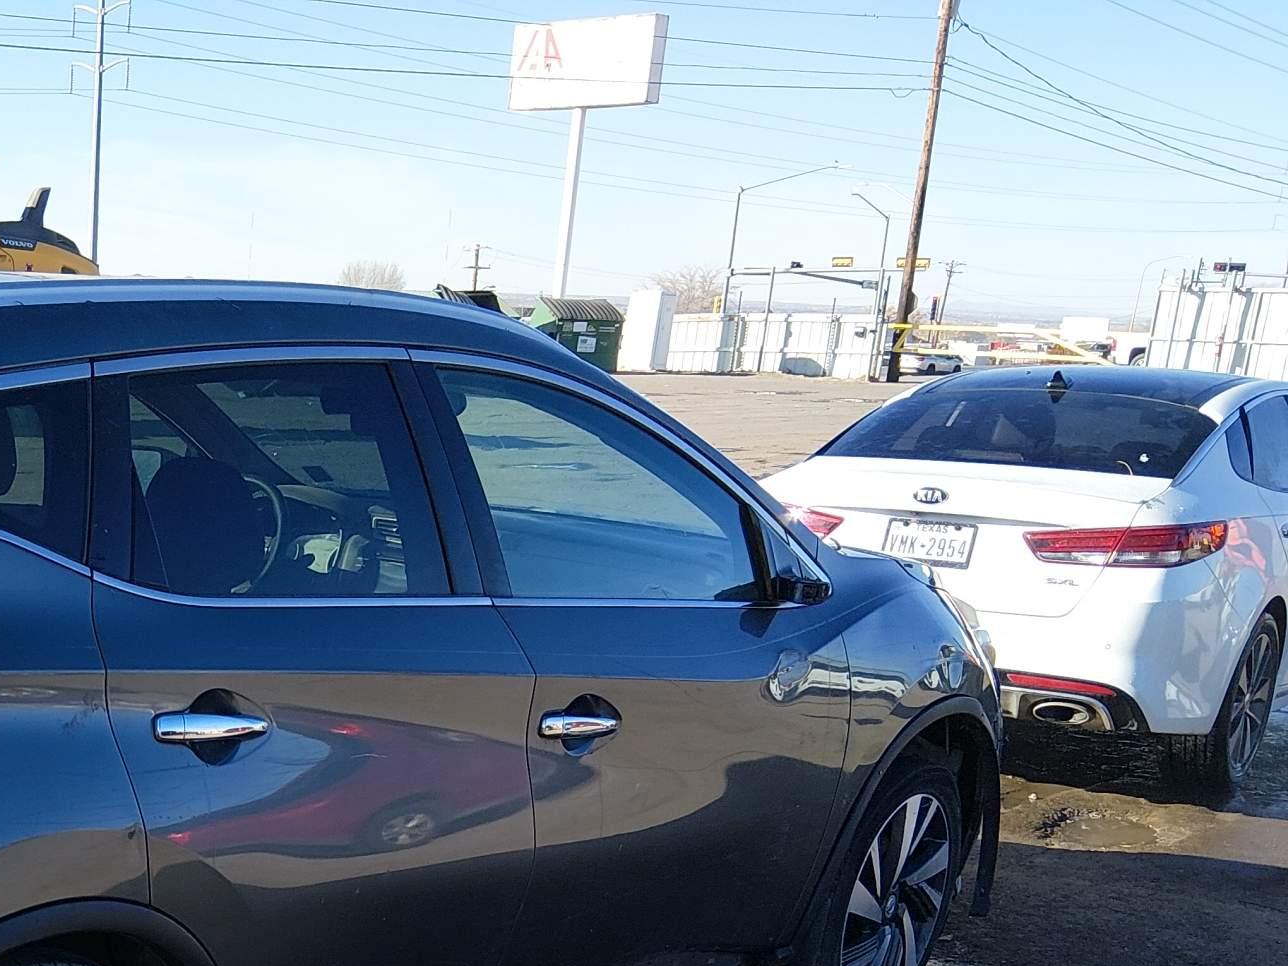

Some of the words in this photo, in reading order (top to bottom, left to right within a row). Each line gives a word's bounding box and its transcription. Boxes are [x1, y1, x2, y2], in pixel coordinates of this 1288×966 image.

[0, 238, 34, 248] VOLVO
[917, 489, 944, 502] KIA
[917, 524, 949, 534] TEXAS
